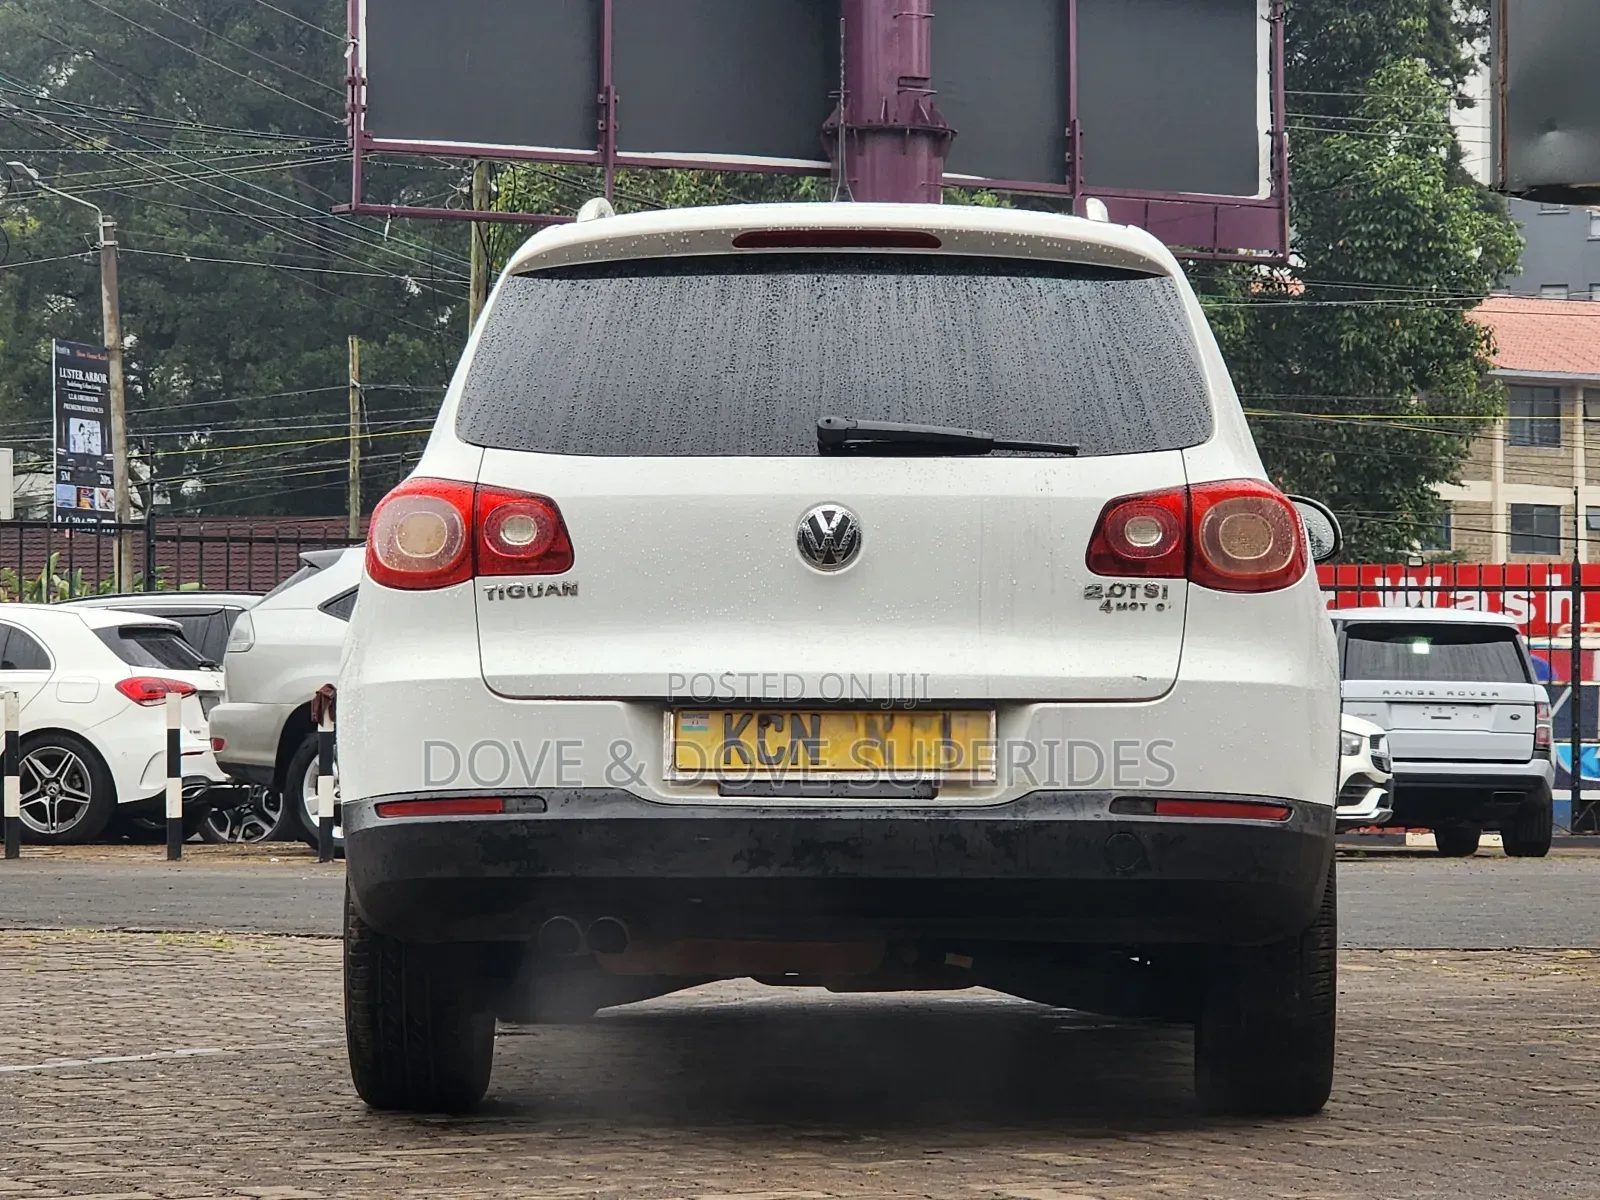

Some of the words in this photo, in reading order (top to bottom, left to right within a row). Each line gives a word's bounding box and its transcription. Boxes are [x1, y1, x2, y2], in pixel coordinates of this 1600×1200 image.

[59, 366, 84, 381] LUSTER
[84, 371, 108, 384] ARBOR
[1374, 573, 1586, 625] Wash
[1446, 690, 1500, 698] ROVER
[722, 712, 822, 766] KCN
